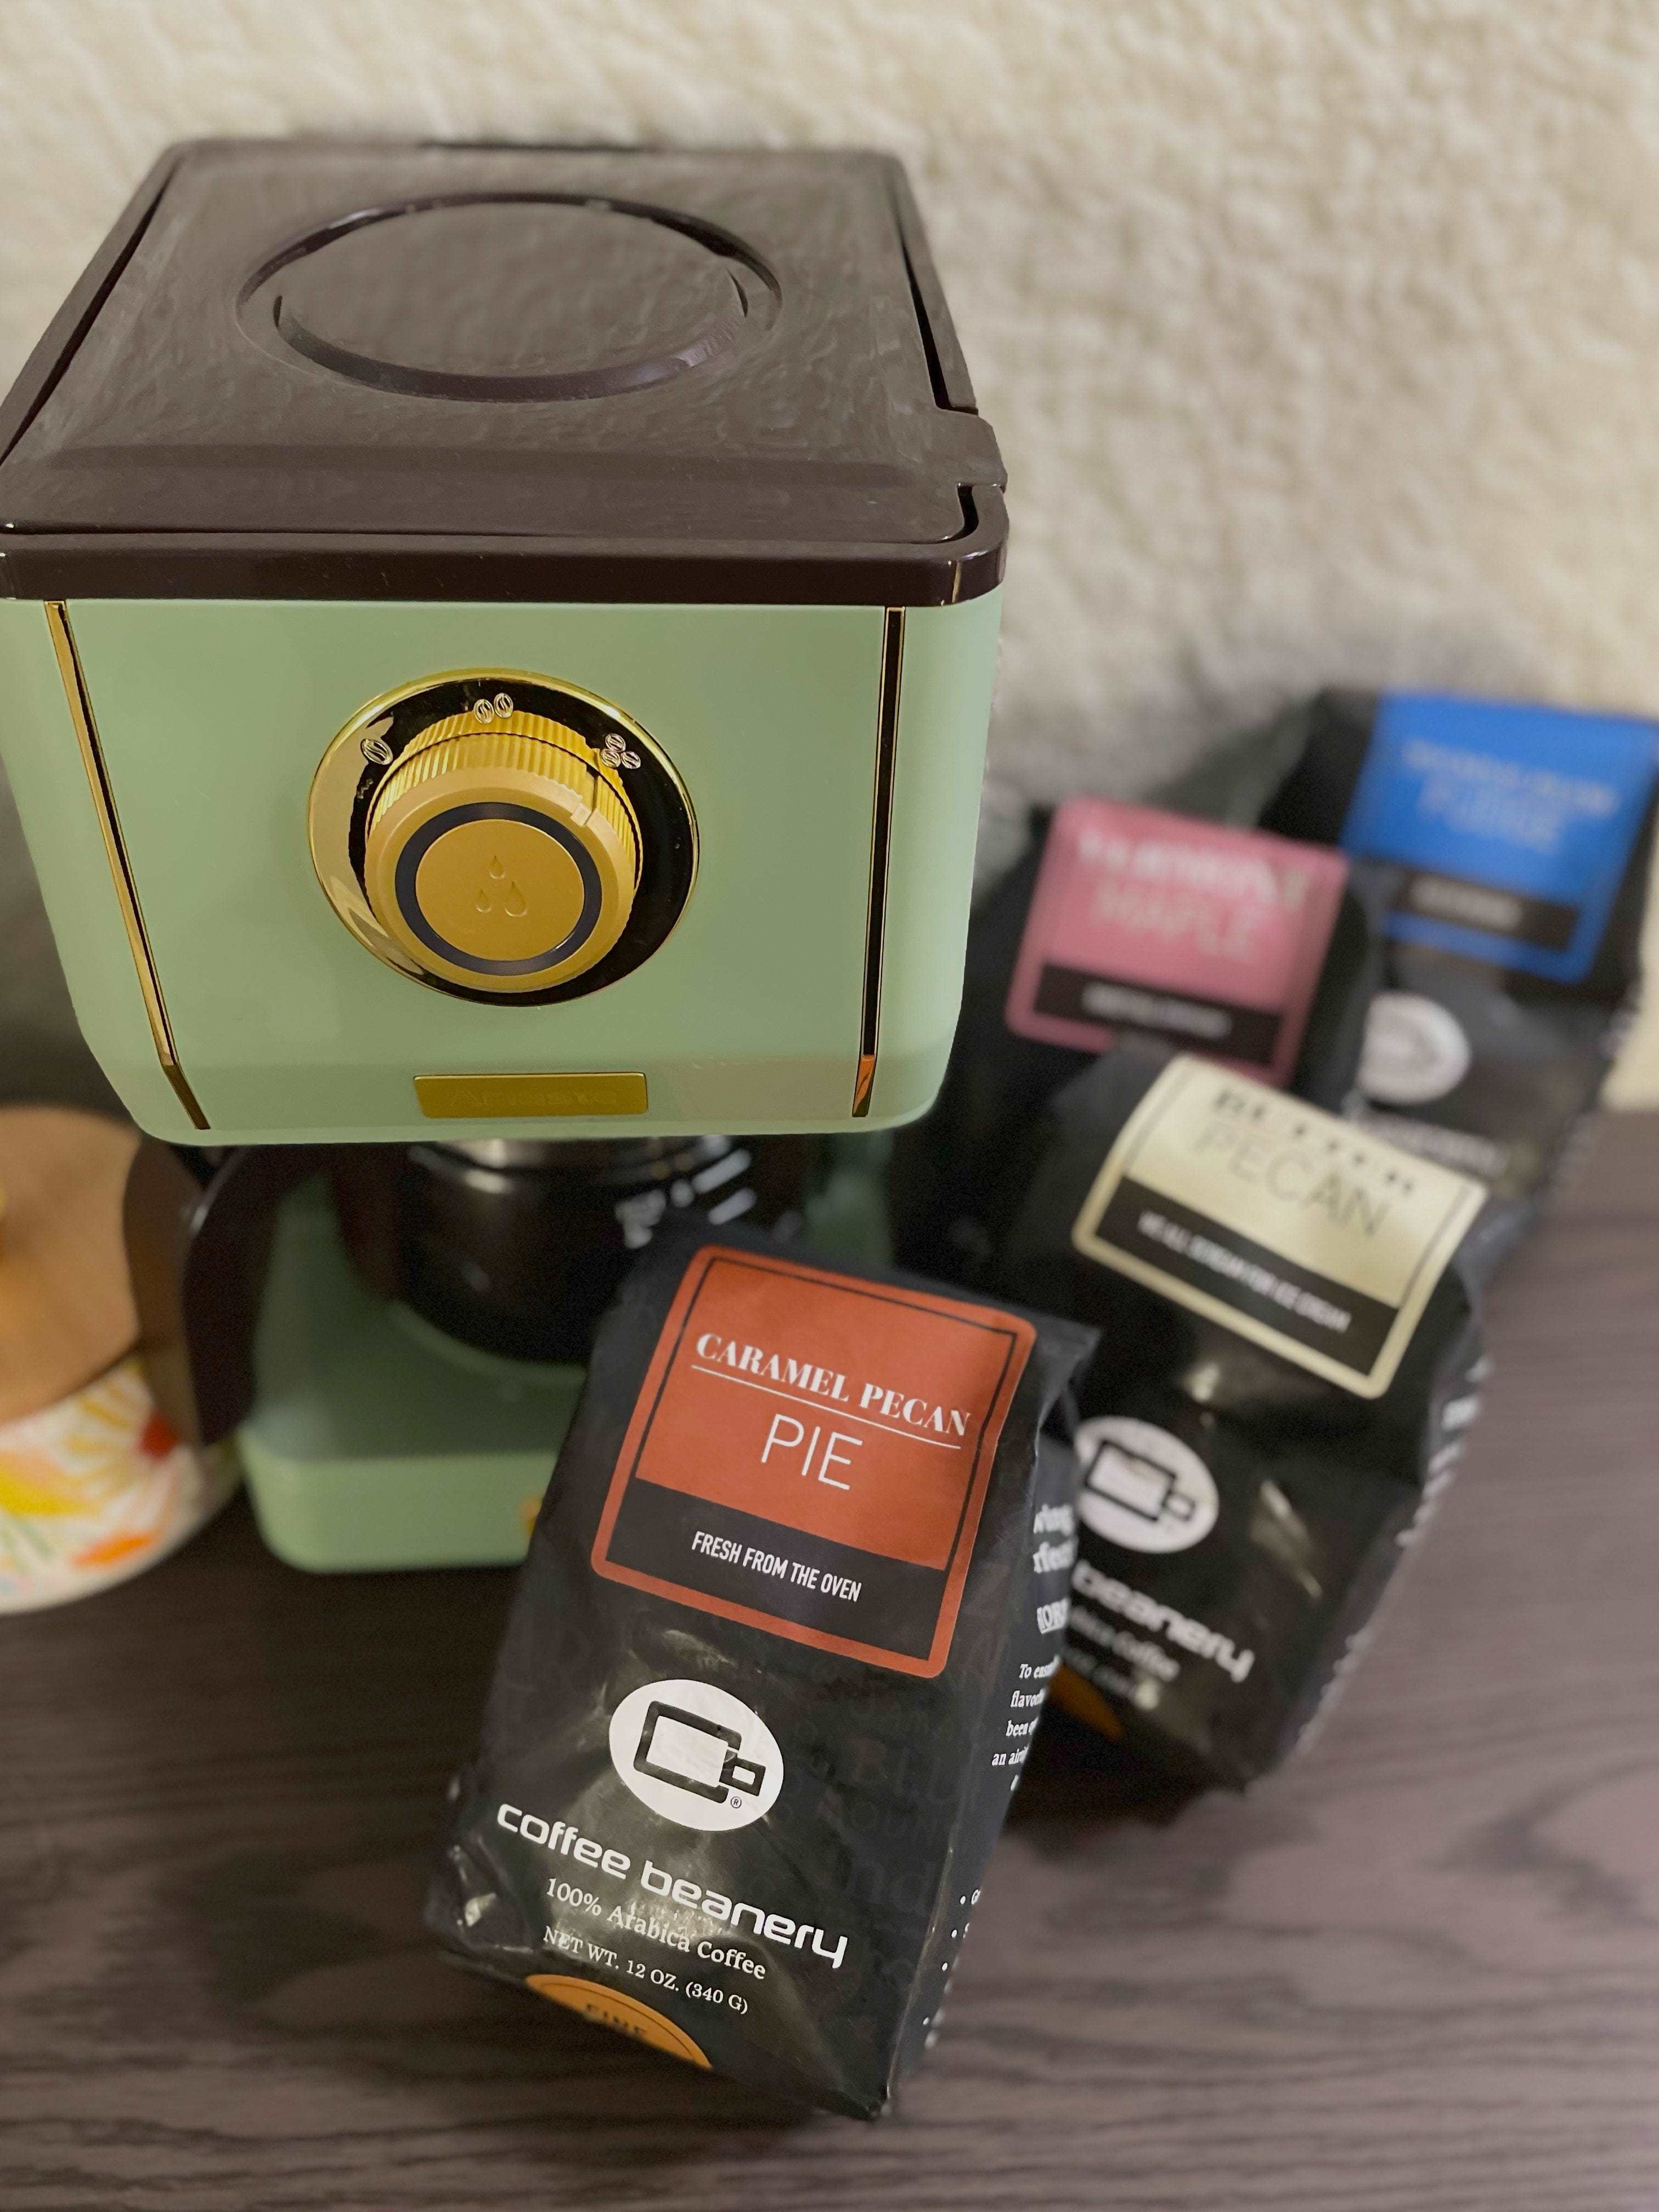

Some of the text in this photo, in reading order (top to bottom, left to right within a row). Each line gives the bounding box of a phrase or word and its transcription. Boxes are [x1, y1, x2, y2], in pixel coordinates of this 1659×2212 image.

[1192, 1120, 1391, 1236] PECAN
[696, 1333, 972, 1436] CARAMEL PECAN
[761, 1413, 862, 1490] PIE
[691, 1531, 862, 1602] FRESH FROM THE OVEN
[1071, 1559, 1255, 1683] beanery
[1019, 1663, 1031, 1679] To
[992, 1753, 1006, 1766] an
[497, 1803, 848, 1968] coffee beanery
[546, 1878, 766, 1979] 100% Arabica Coffee
[543, 1926, 748, 2014] NET WT. 12 OZ. (340 G)
